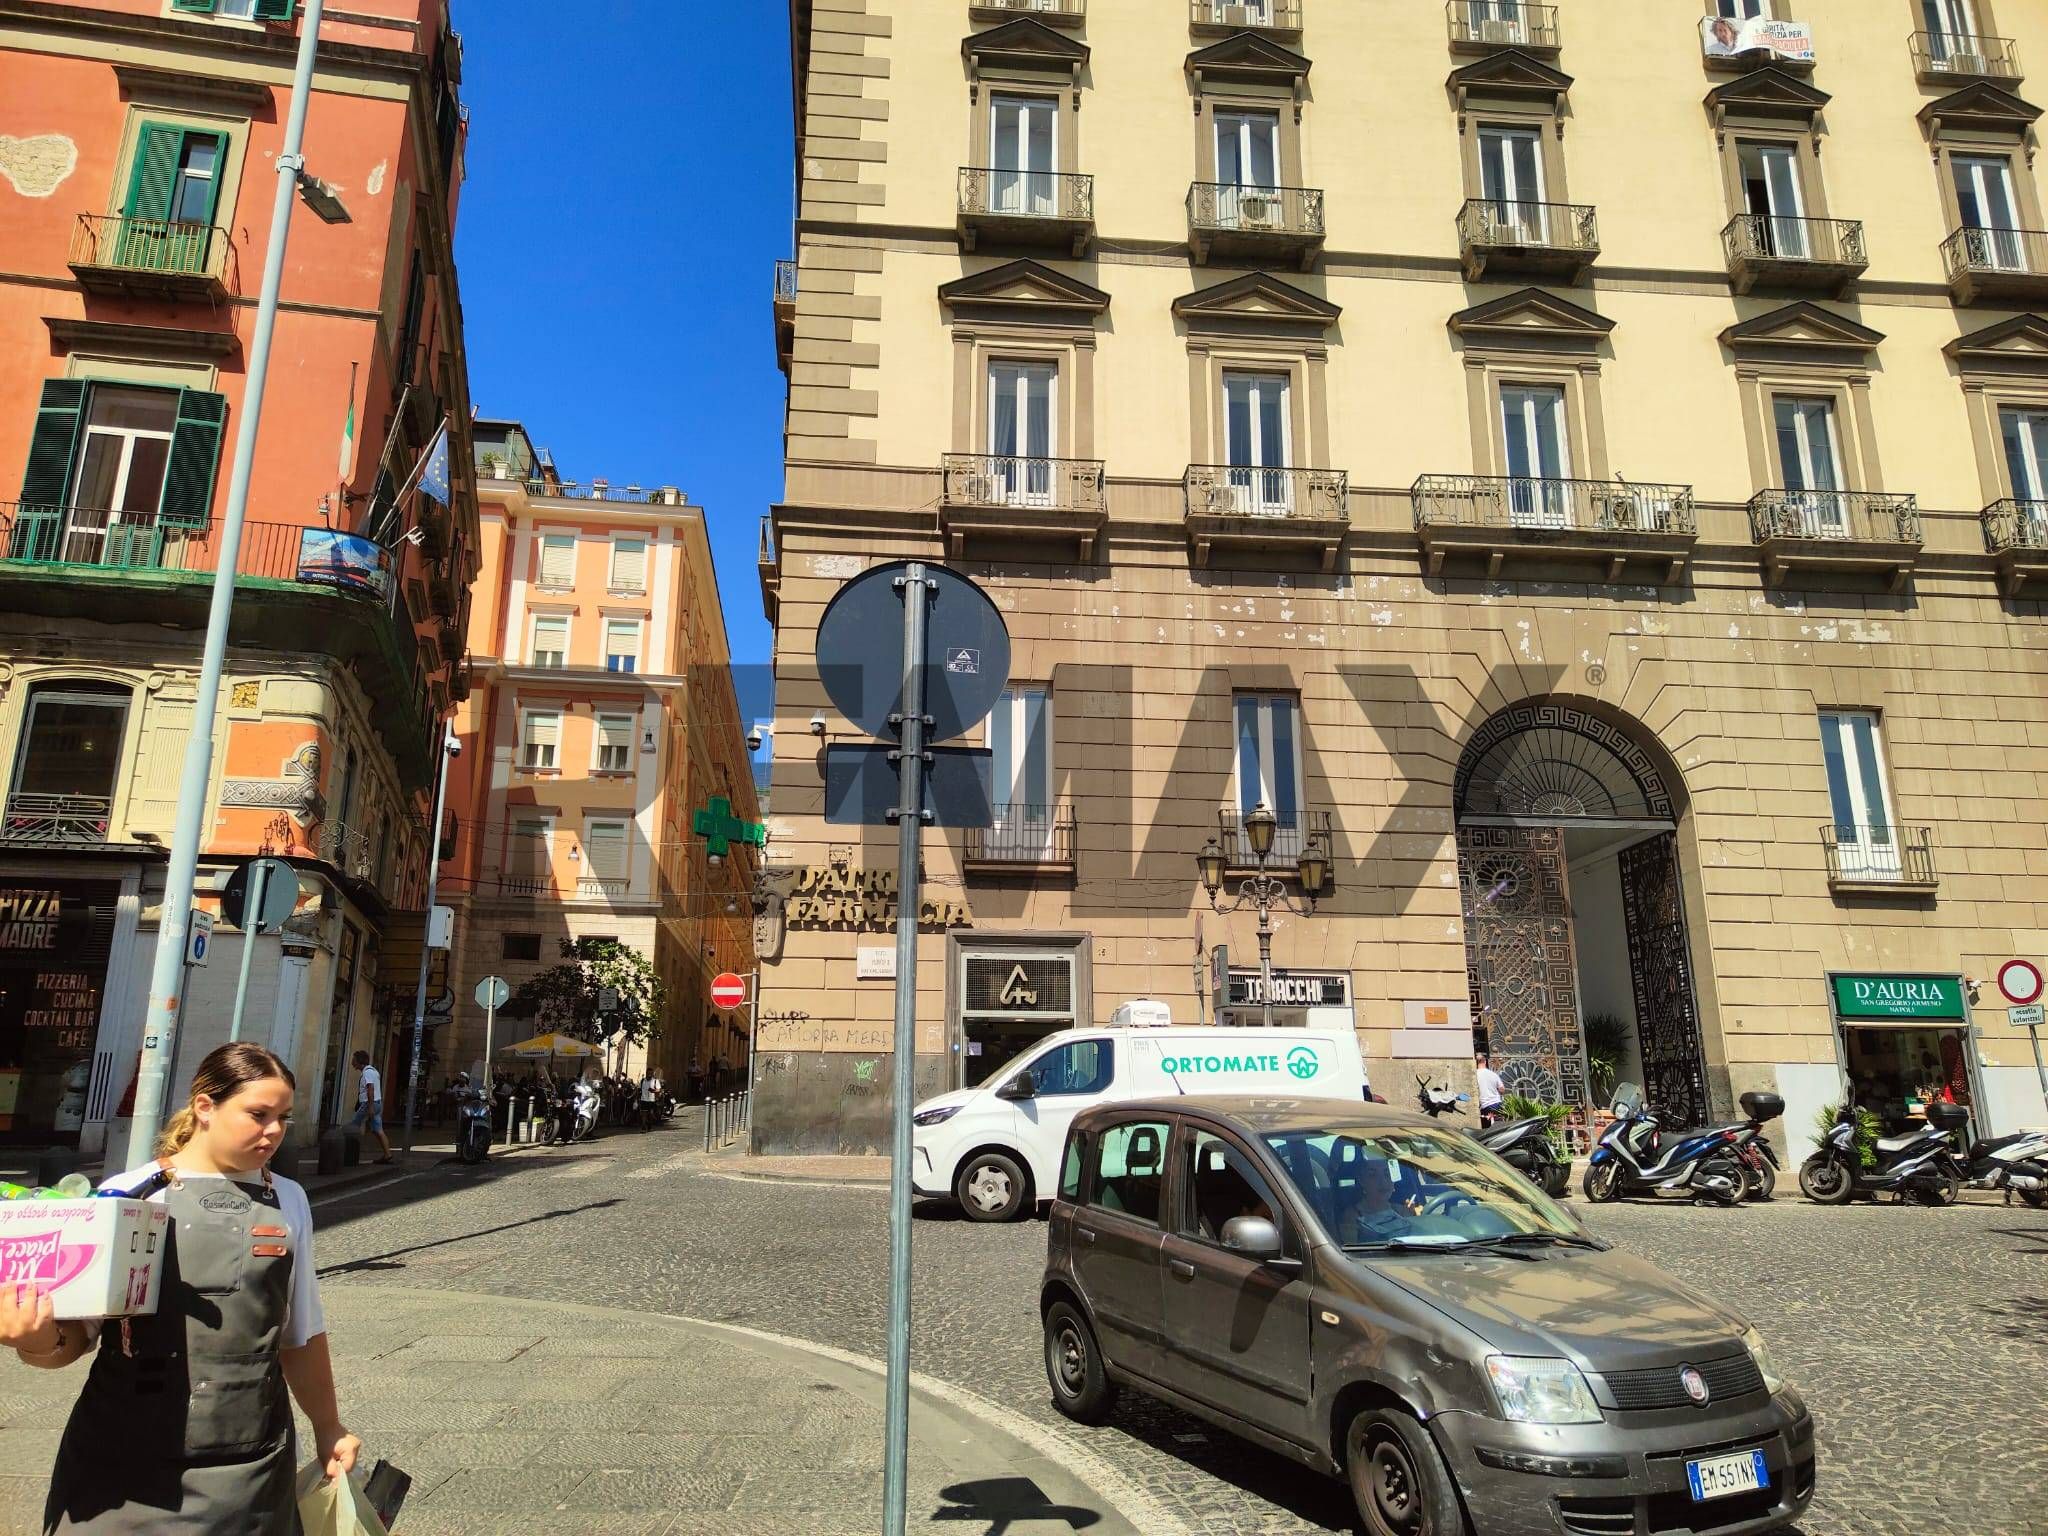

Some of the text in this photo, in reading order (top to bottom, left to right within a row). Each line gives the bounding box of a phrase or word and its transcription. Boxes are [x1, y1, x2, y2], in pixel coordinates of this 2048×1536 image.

[1789, 30, 1802, 38] PER
[0, 889, 61, 922] PIZZA
[786, 896, 973, 925] FARMCIA
[36, 973, 88, 989] PIZZERIA
[1854, 981, 1944, 1000] D'AURIA
[53, 992, 94, 1008] CUCINA
[24, 1010, 95, 1026] COCKTAIL BAR
[1161, 1055, 1280, 1073] ORTOMATE
